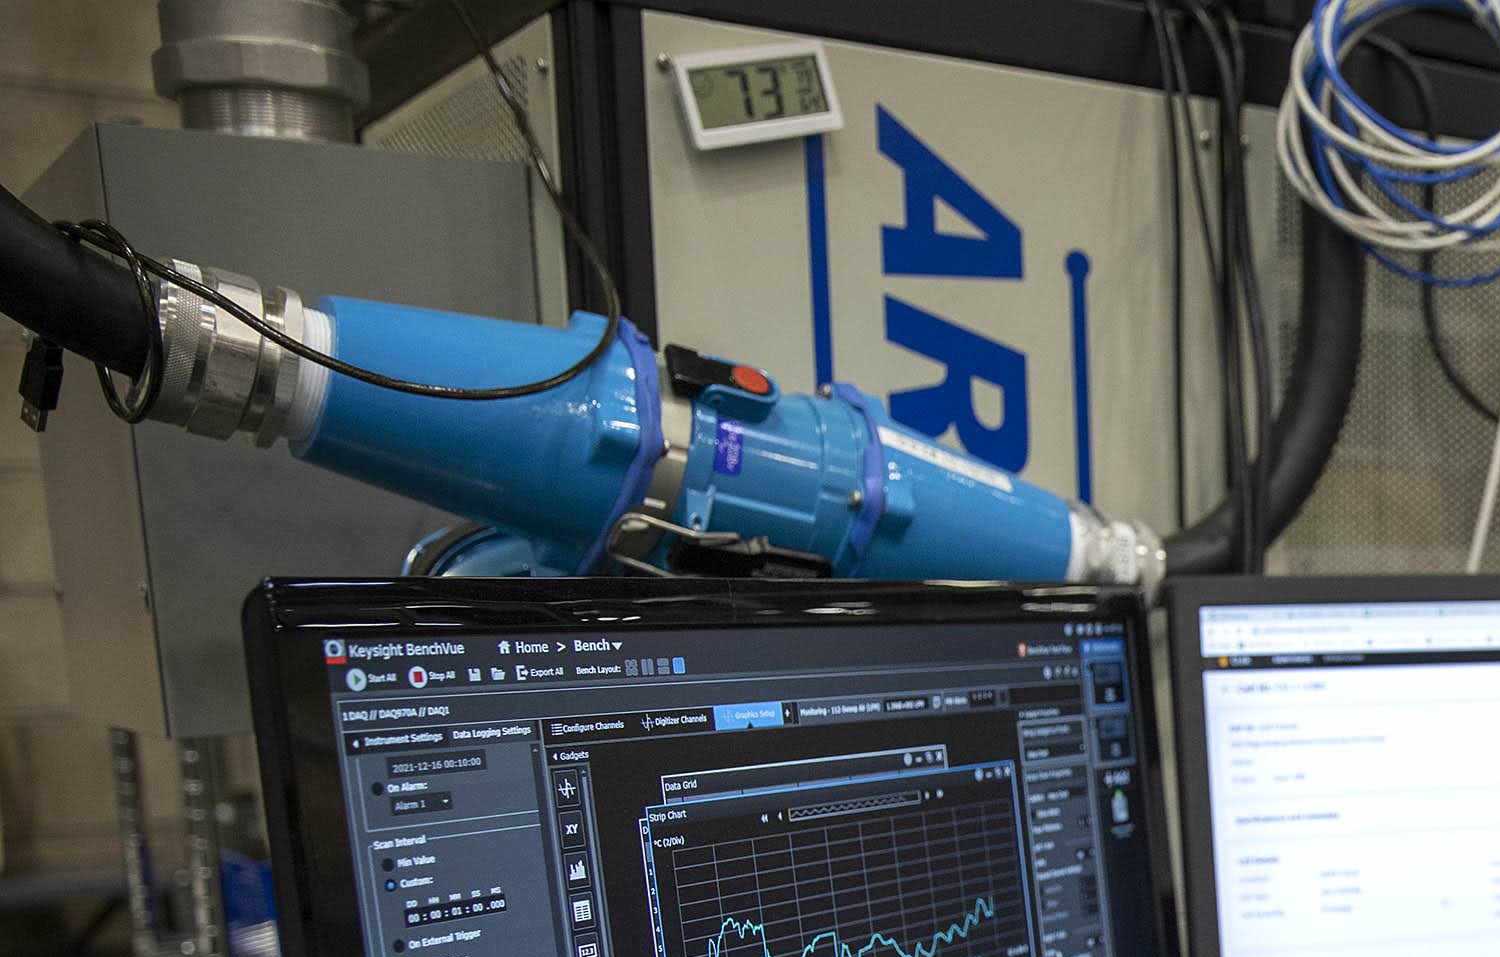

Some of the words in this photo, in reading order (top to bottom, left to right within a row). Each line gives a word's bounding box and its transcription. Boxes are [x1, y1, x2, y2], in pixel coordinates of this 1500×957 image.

[724, 63, 786, 119] 73
[875, 104, 1029, 475] AR
[349, 643, 403, 659] Keysight
[406, 641, 465, 656] BenchVue
[515, 641, 549, 653] Home
[574, 639, 610, 652] Bench
[429, 671, 444, 682] Stop
[445, 670, 455, 680] All
[530, 667, 552, 679] Export
[553, 667, 564, 676] All
[576, 665, 595, 675] Bench
[597, 663, 621, 676] Layout:
[368, 673, 385, 684] Start
[385, 672, 396, 682] All
[428, 705, 449, 716] DAQ1
[655, 716, 679, 728] Digitizer
[680, 713, 707, 725] Channels
[453, 729, 470, 740] Data
[472, 727, 500, 741] Logging
[502, 725, 532, 738] Settings
[562, 723, 594, 735] Configure
[595, 720, 624, 732] Channels
[364, 734, 407, 747] Instrument
[408, 731, 442, 745] Settings
[560, 750, 589, 763] Gadgets
[392, 759, 442, 773] 2021-12-16
[387, 782, 399, 792] On
[401, 780, 428, 792] Alarm:
[665, 782, 681, 792] Data
[682, 779, 697, 790] Grid
[395, 801, 418, 811] Alarm
[649, 812, 666, 823] Strip
[668, 810, 687, 820] Chart
[565, 823, 578, 835] XY
[373, 838, 393, 850] Scan
[395, 835, 427, 847] Interval
[397, 858, 411, 868] Min
[413, 854, 435, 866] Value
[400, 876, 433, 888] Custom:
[471, 890, 481, 898] SS
[409, 939, 421, 949] On
[422, 933, 454, 948] External
[455, 929, 482, 943] Trigger
